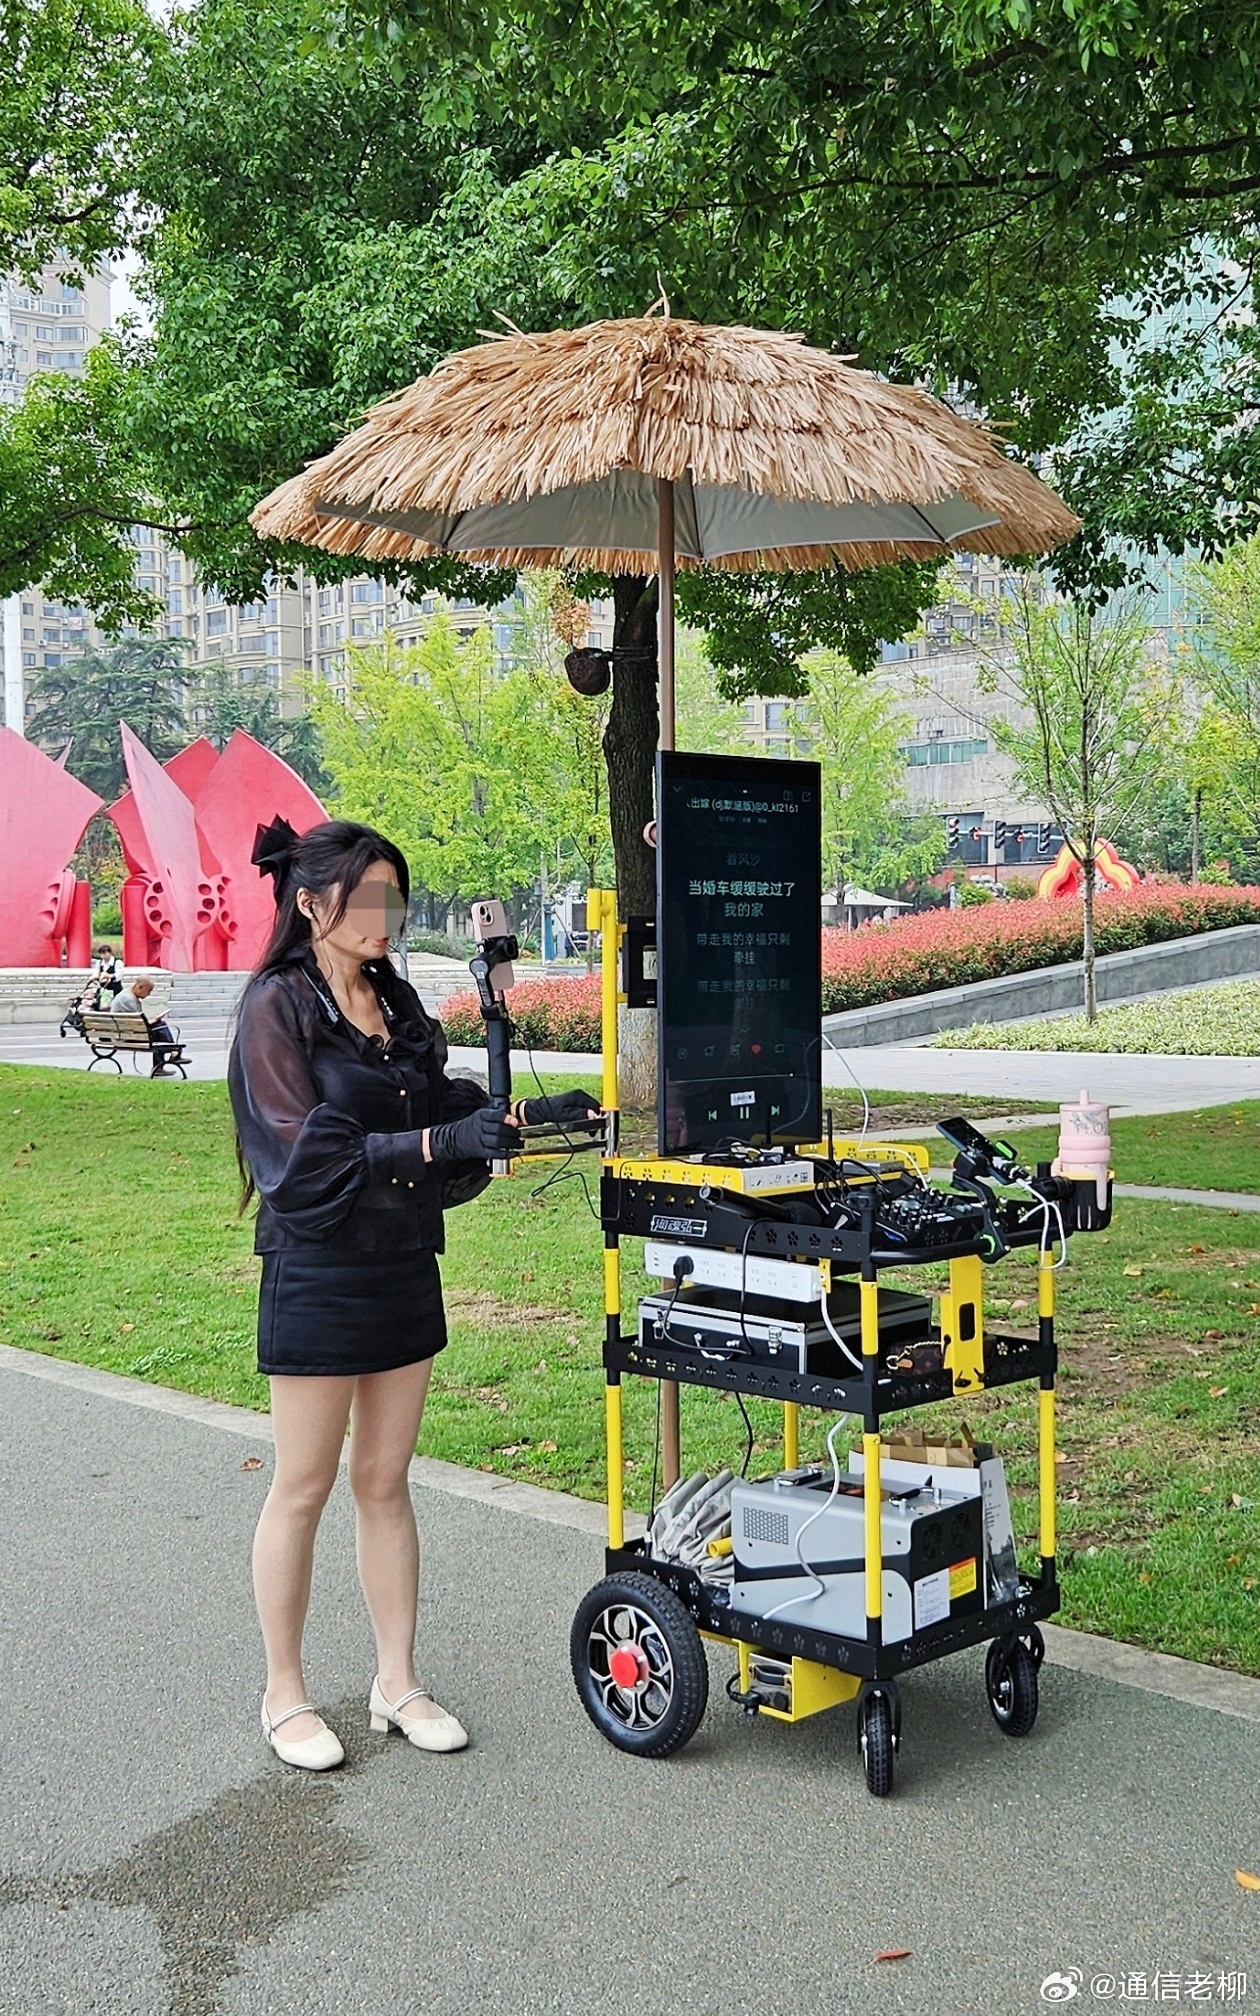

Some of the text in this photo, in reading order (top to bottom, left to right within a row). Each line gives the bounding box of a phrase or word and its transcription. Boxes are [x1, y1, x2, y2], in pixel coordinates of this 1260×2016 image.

[689, 880, 795, 897] 当婚车缓缓驶过了
[724, 902, 764, 917] 我的家
[696, 932, 791, 946] 带走我的幸福只剩
